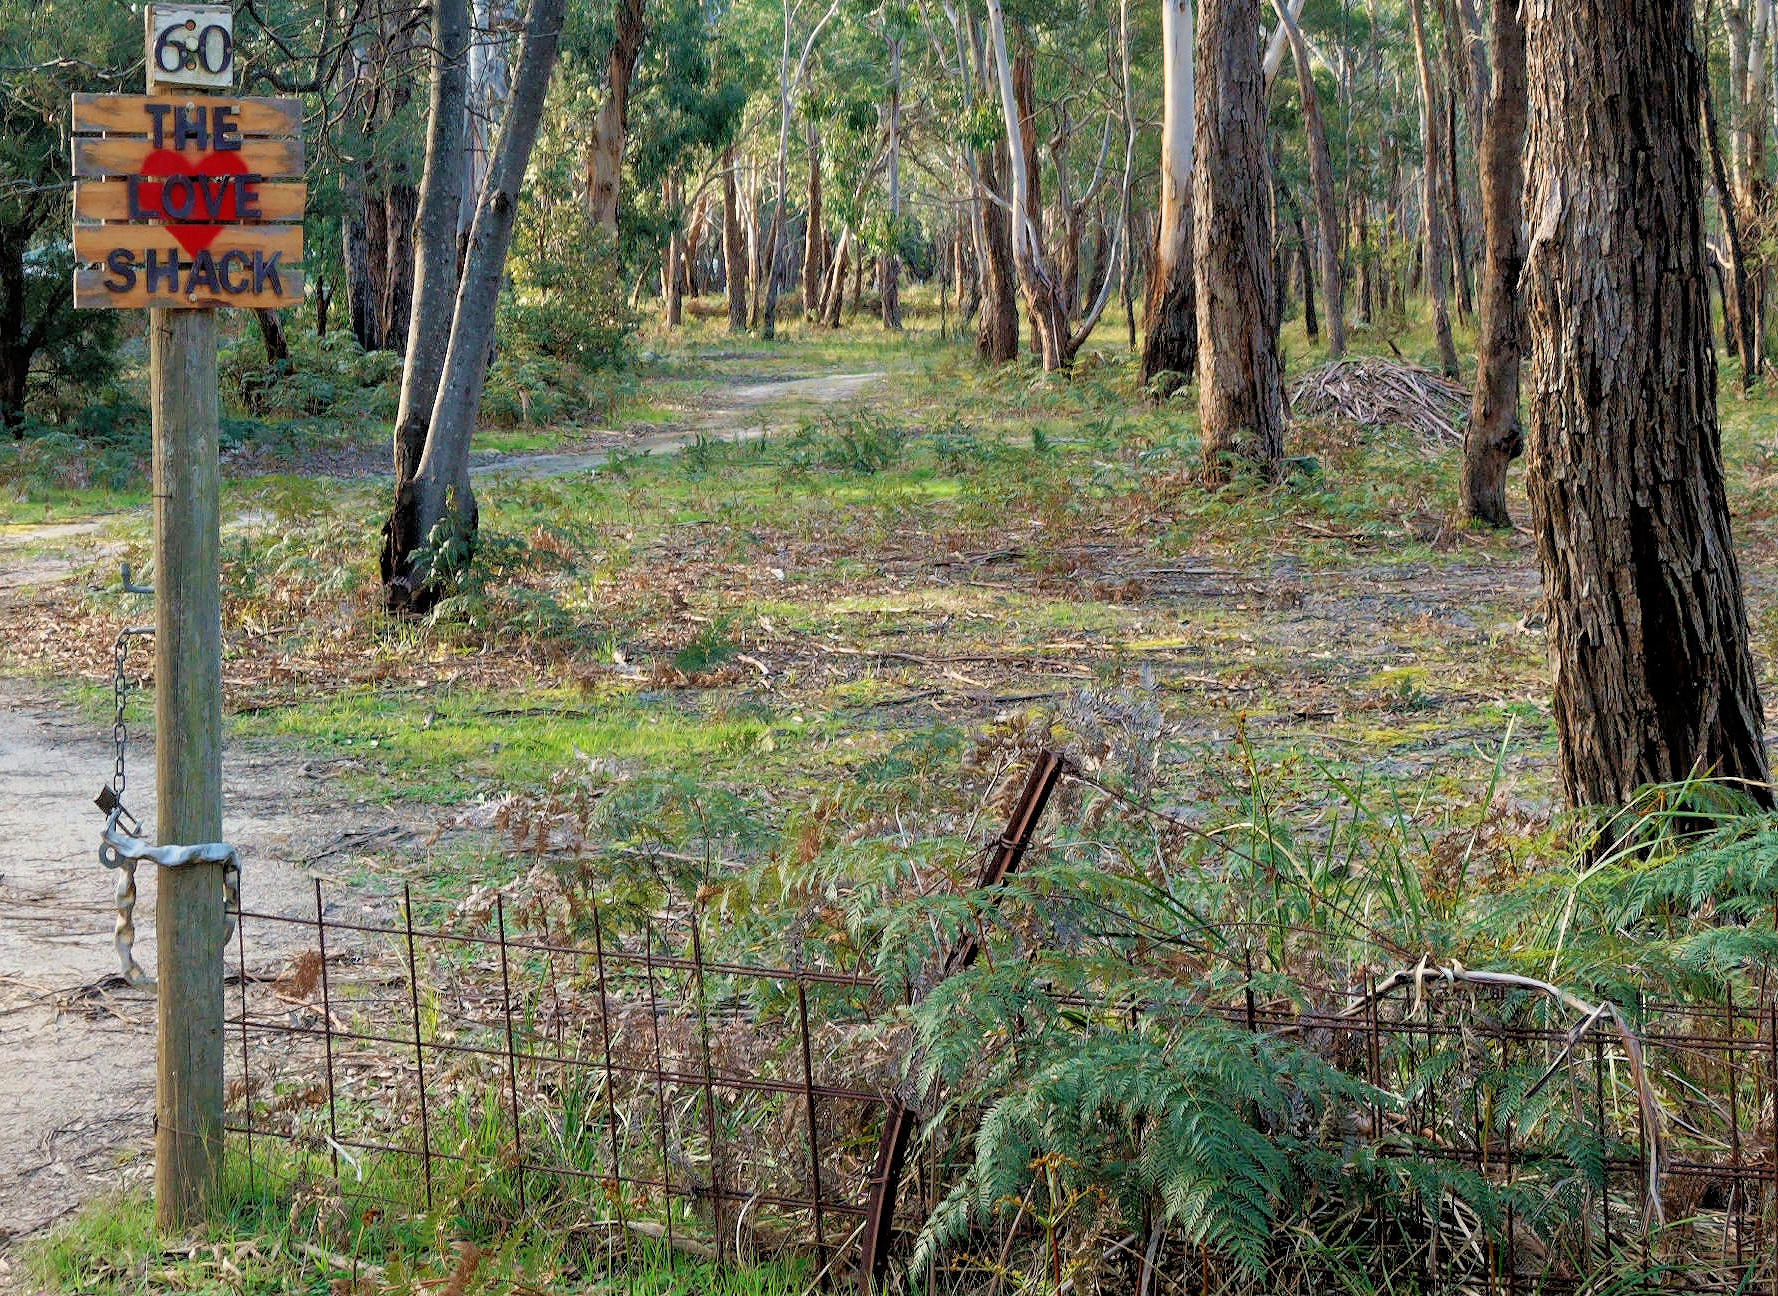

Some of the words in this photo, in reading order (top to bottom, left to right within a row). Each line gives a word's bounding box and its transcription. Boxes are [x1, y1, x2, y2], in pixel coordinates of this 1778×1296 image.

[154, 24, 232, 74] 60
[145, 104, 242, 151] THE
[128, 173, 263, 219] LOVE
[104, 248, 284, 295] SHACK
